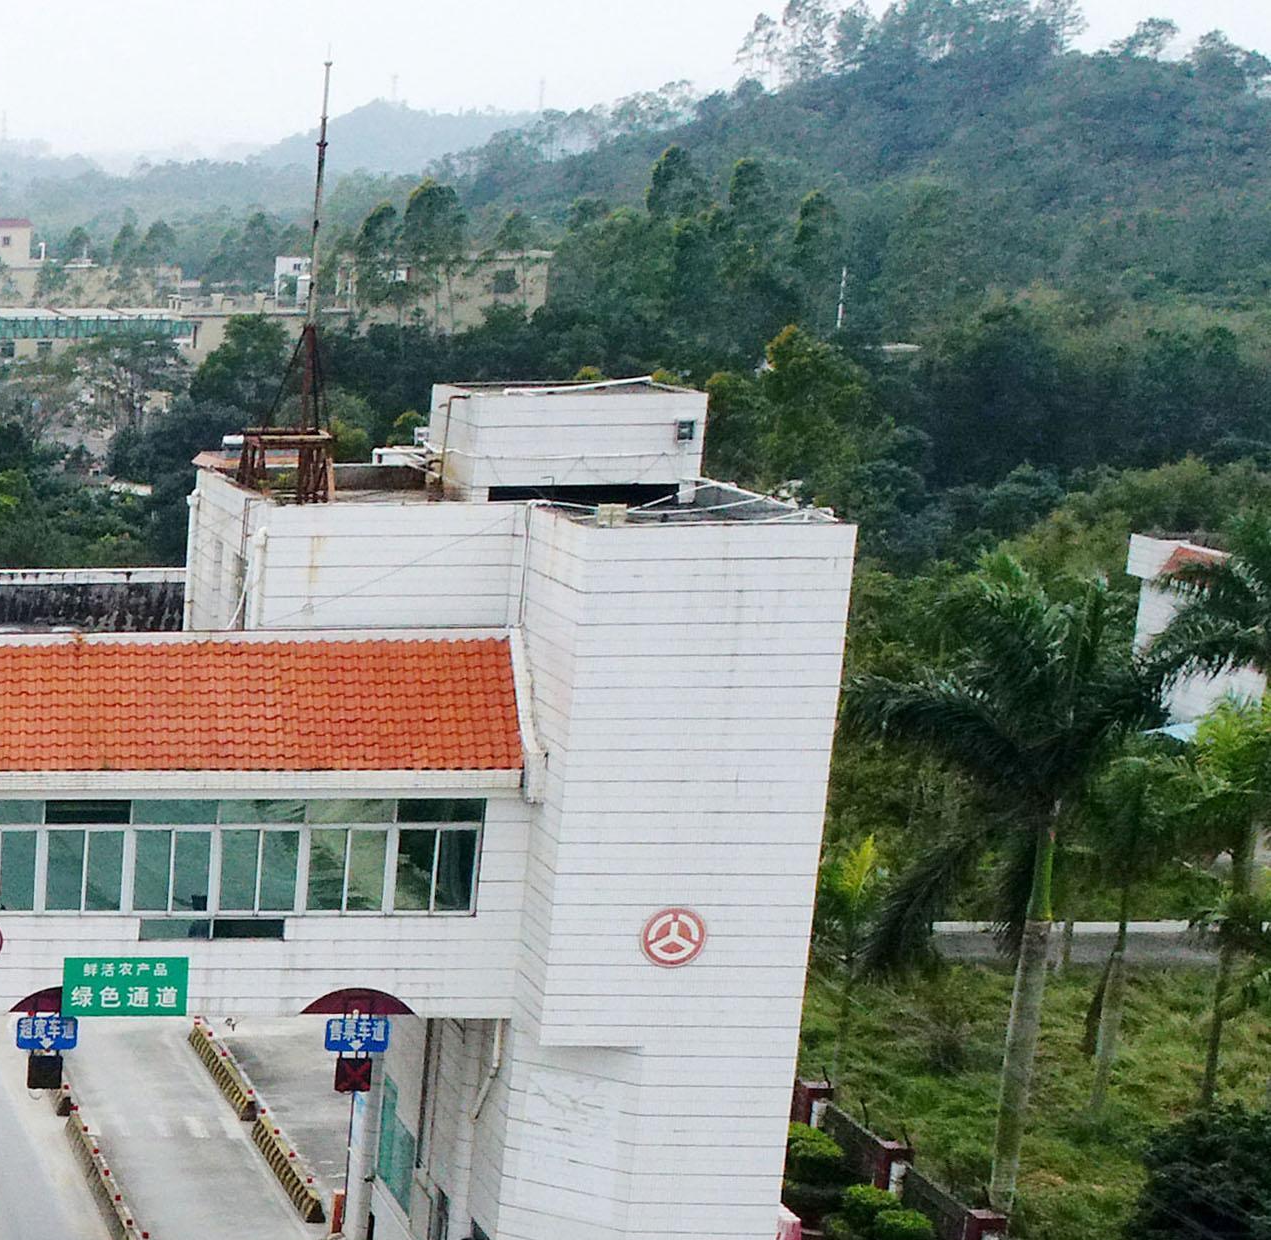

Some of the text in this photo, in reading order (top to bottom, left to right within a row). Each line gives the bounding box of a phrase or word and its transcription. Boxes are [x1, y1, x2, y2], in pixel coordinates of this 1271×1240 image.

[83, 962, 168, 977] 鲜活农产品
[70, 986, 178, 1008] 绿色通道
[329, 1020, 385, 1041] 售票车道
